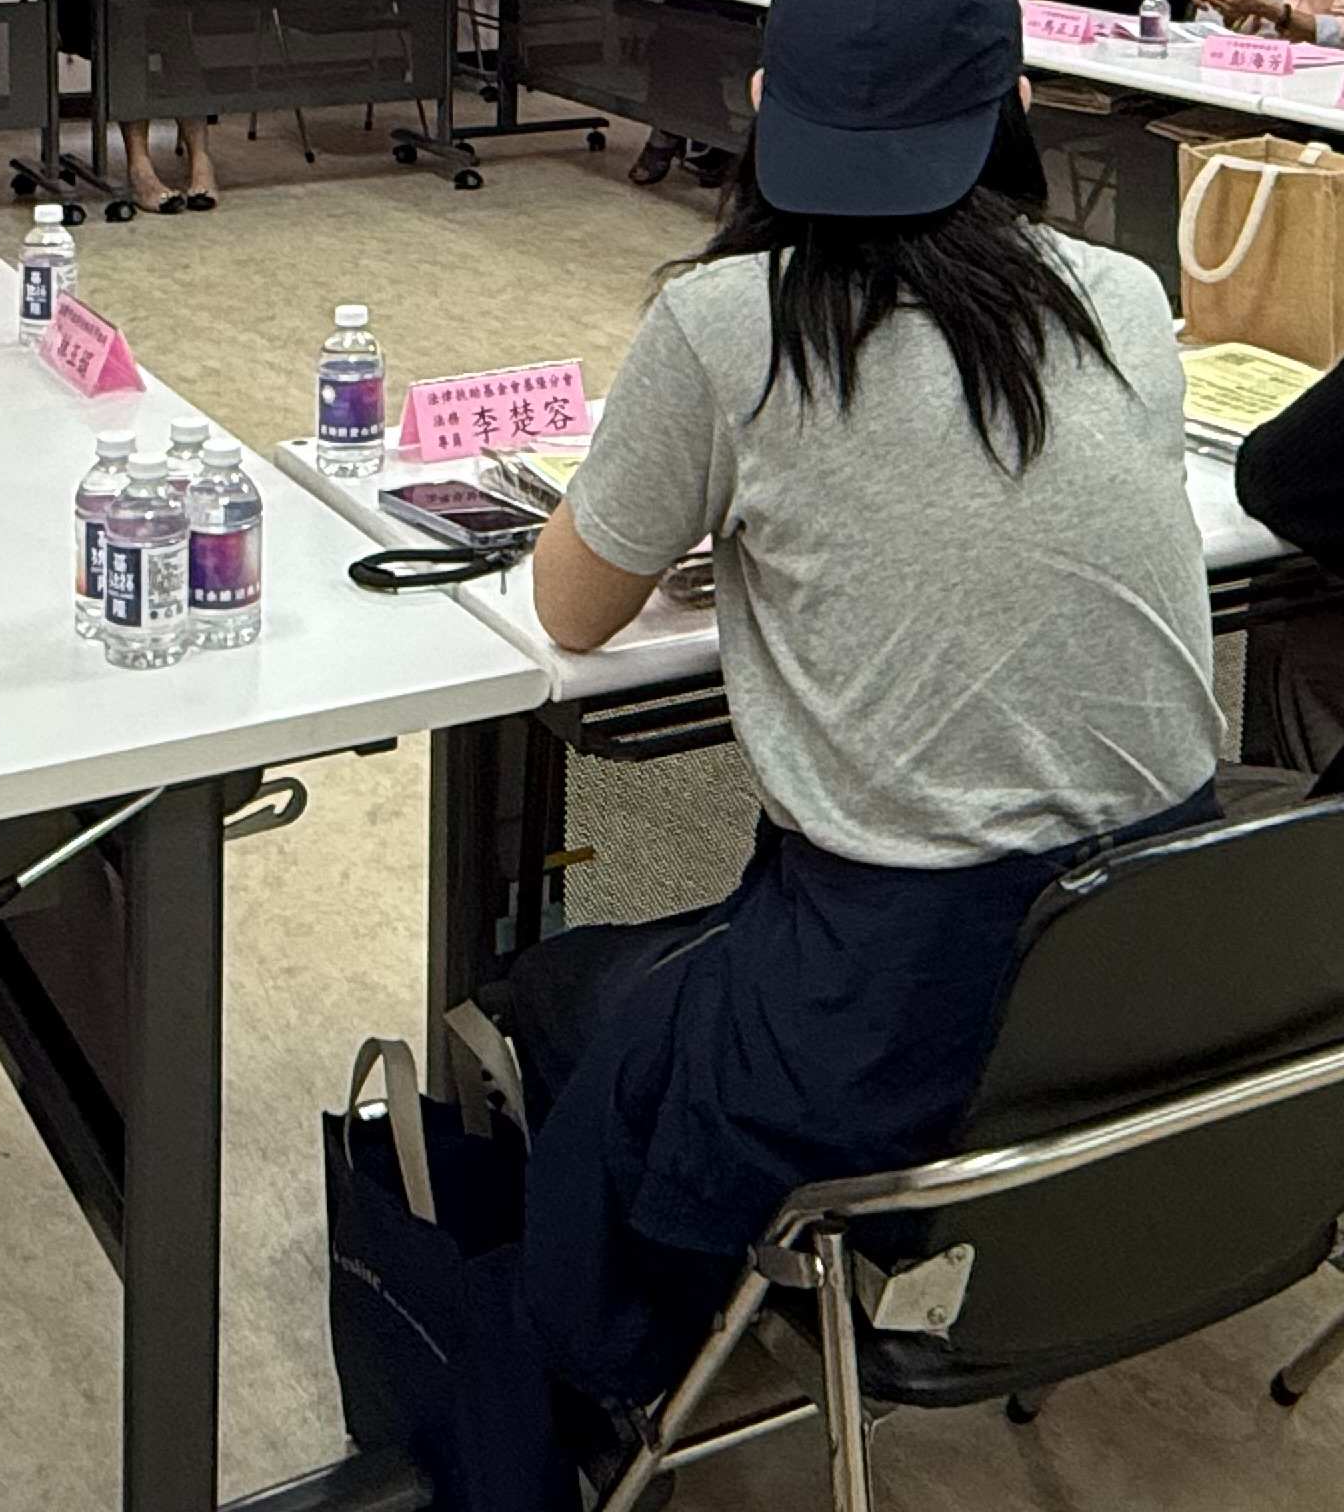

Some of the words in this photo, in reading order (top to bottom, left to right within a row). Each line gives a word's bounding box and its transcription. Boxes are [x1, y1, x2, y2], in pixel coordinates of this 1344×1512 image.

[427, 372, 573, 406] 法律扶助基金會基隆分會
[471, 395, 577, 445] 李楚容
[438, 432, 463, 450] 專員
